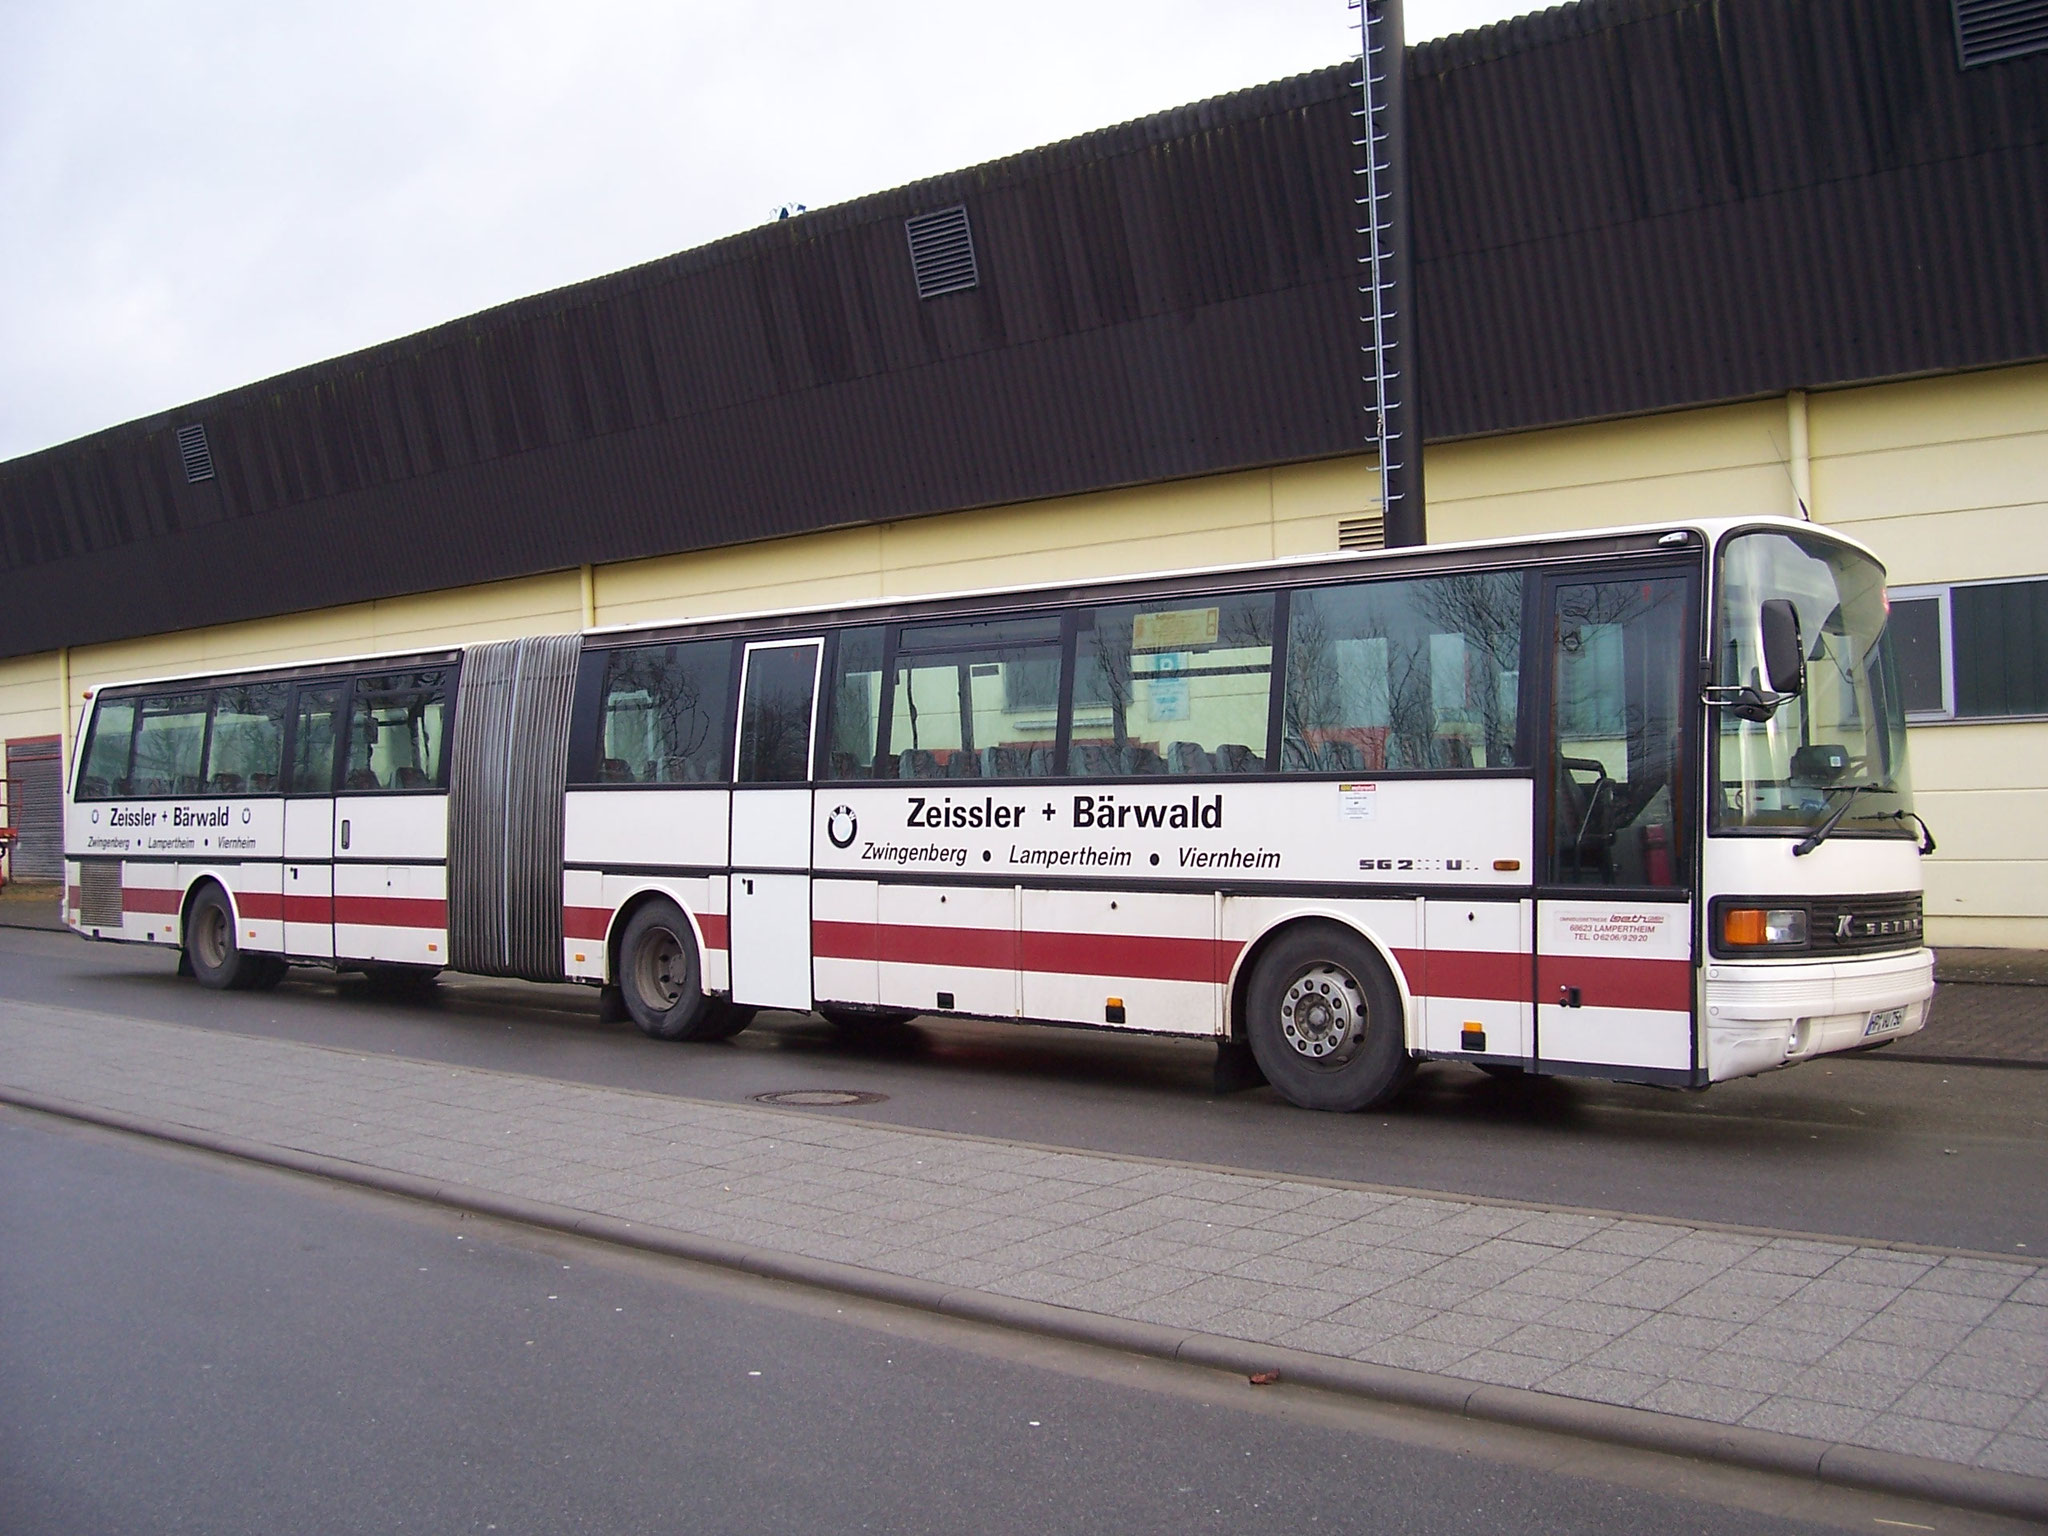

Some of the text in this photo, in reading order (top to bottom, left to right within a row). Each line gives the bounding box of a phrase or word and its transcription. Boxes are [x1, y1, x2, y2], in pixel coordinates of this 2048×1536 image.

[110, 807, 157, 827] Zeissler
[173, 806, 230, 827] Bärwald
[906, 795, 1223, 829] Zeissler + Bärwald
[87, 836, 256, 851] Zwingenberg Lampertheim Viernheim
[861, 842, 1281, 869] Zwingenberg Lampertheim Viernheim
[1359, 859, 1392, 871] SG
[1569, 924, 1656, 934] 68623 LAMPERTHEIM
[1574, 933, 1591, 942] TEL.
